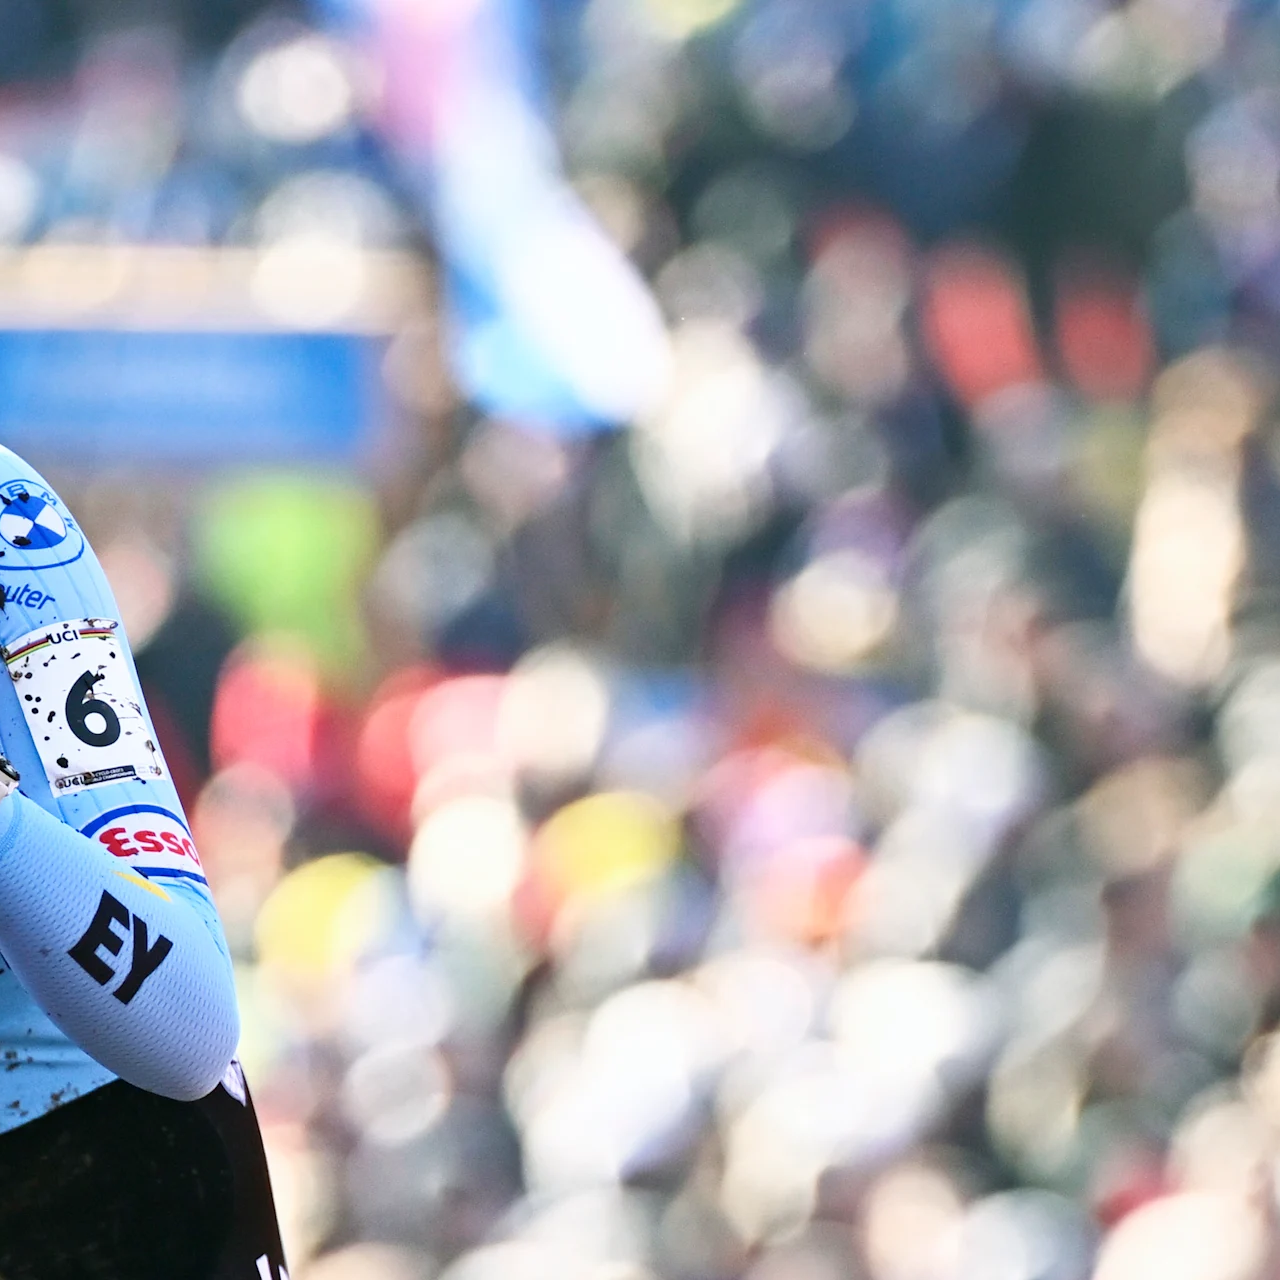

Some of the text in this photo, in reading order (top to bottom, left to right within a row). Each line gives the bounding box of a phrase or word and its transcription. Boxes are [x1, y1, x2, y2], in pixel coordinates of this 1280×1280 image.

[49, 629, 80, 645] UCI
[65, 669, 121, 747] 6
[68, 888, 174, 1006] EY
